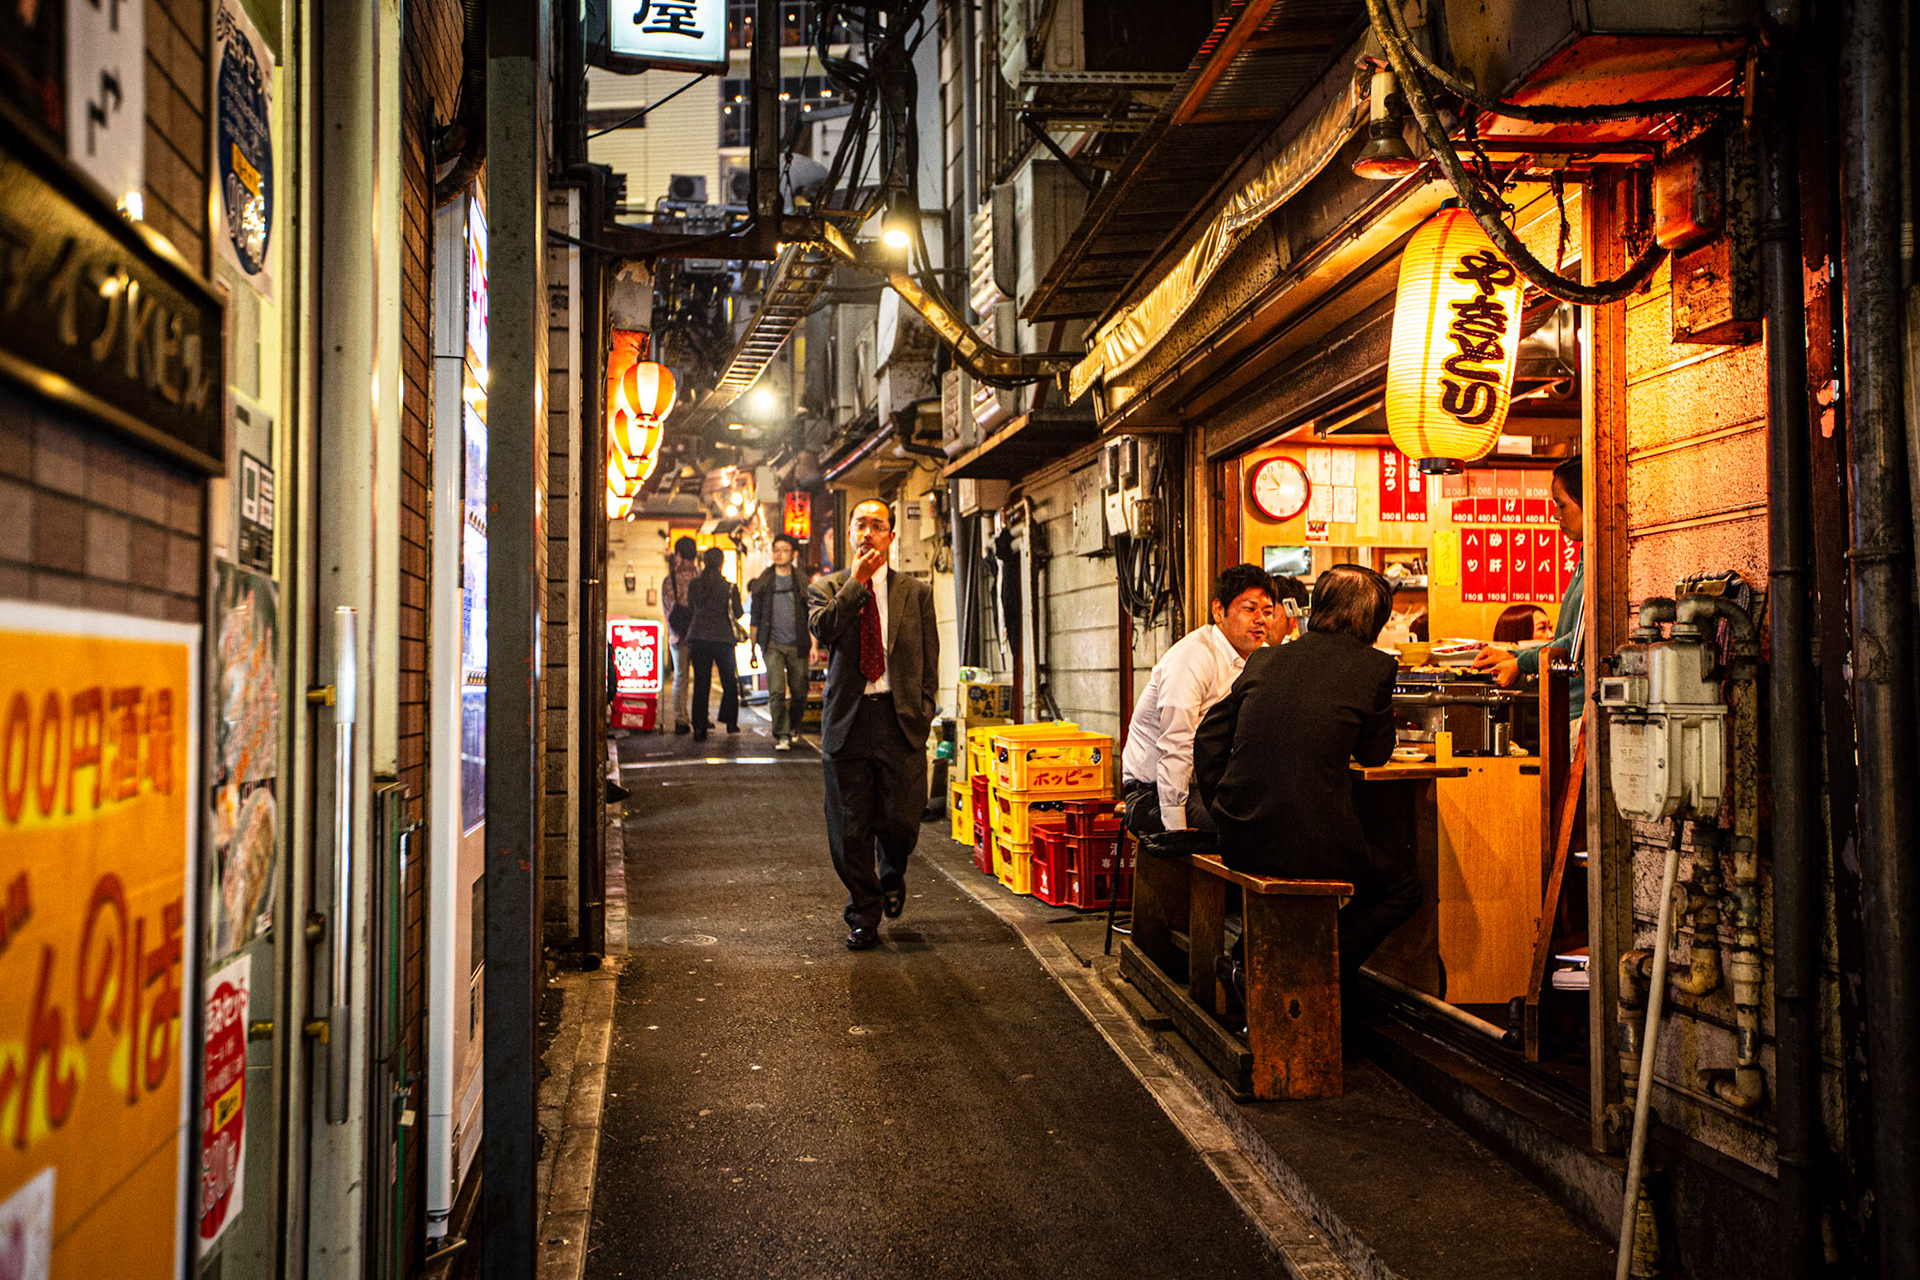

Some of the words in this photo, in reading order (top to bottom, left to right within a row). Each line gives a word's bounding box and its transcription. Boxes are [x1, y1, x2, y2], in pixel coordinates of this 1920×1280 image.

[1441, 249, 1516, 425] やきとり
[1466, 533, 1478, 572] ハツ
[1489, 532, 1502, 573] 砂肝
[1514, 533, 1526, 572] タン
[1538, 533, 1551, 573] レバ
[1033, 768, 1094, 786] ホッピー
